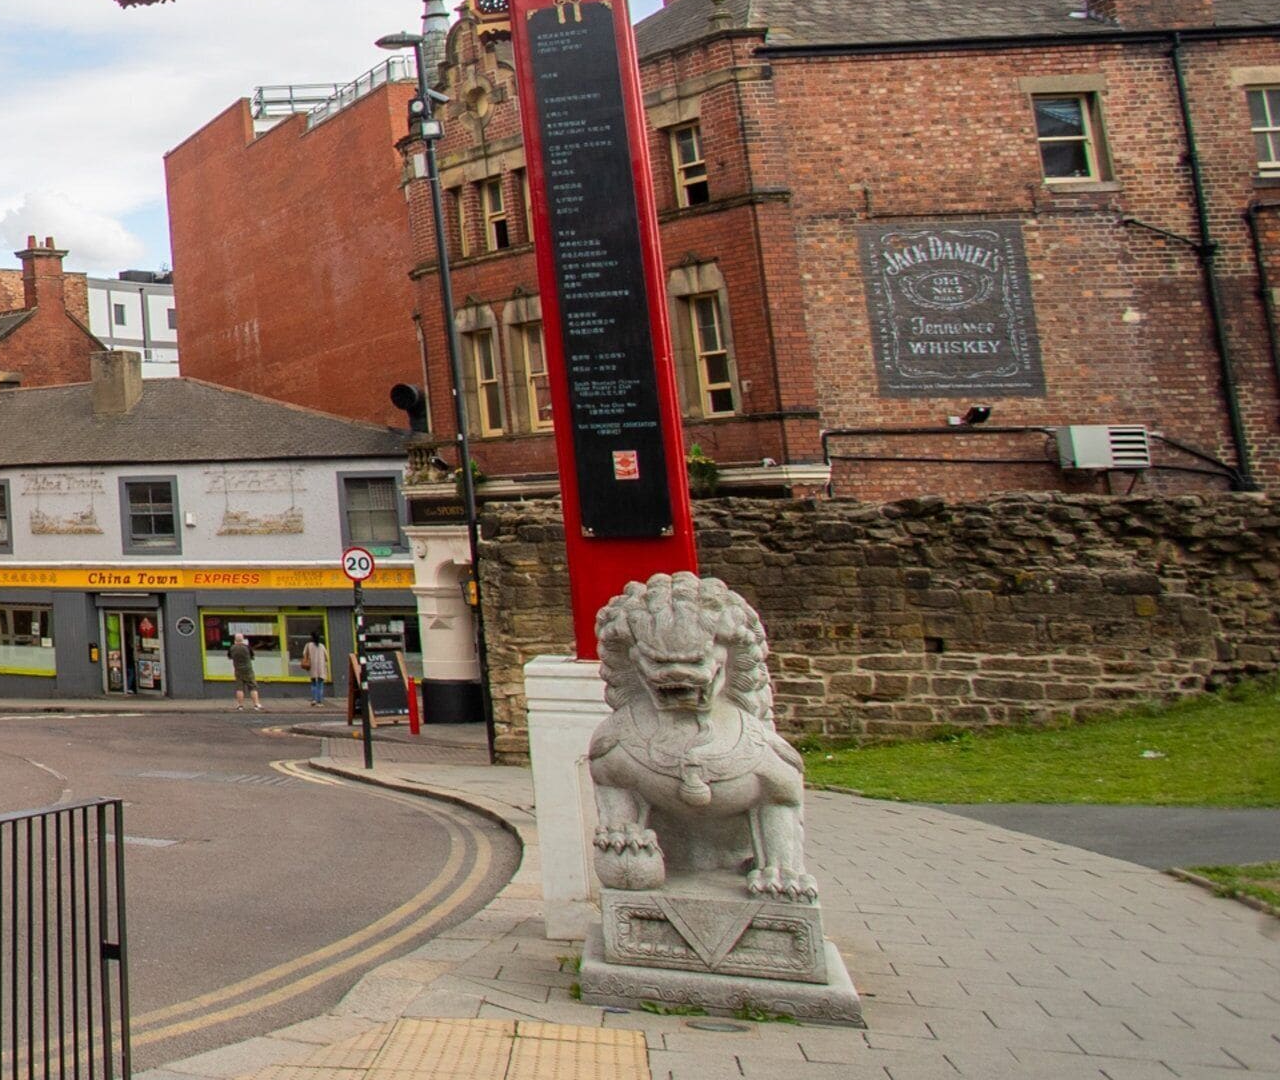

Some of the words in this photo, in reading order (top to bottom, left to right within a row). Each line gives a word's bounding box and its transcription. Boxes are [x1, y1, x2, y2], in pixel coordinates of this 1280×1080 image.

[882, 244, 929, 276] JACK
[927, 235, 1004, 273] DANIEL'S
[933, 276, 960, 286] Old
[910, 316, 996, 336] Tennessee
[908, 340, 1001, 355] WHISKEY
[345, 557, 371, 571] 20
[87, 572, 132, 585] China
[137, 572, 179, 585] Town
[193, 572, 261, 584] EXPRESS
